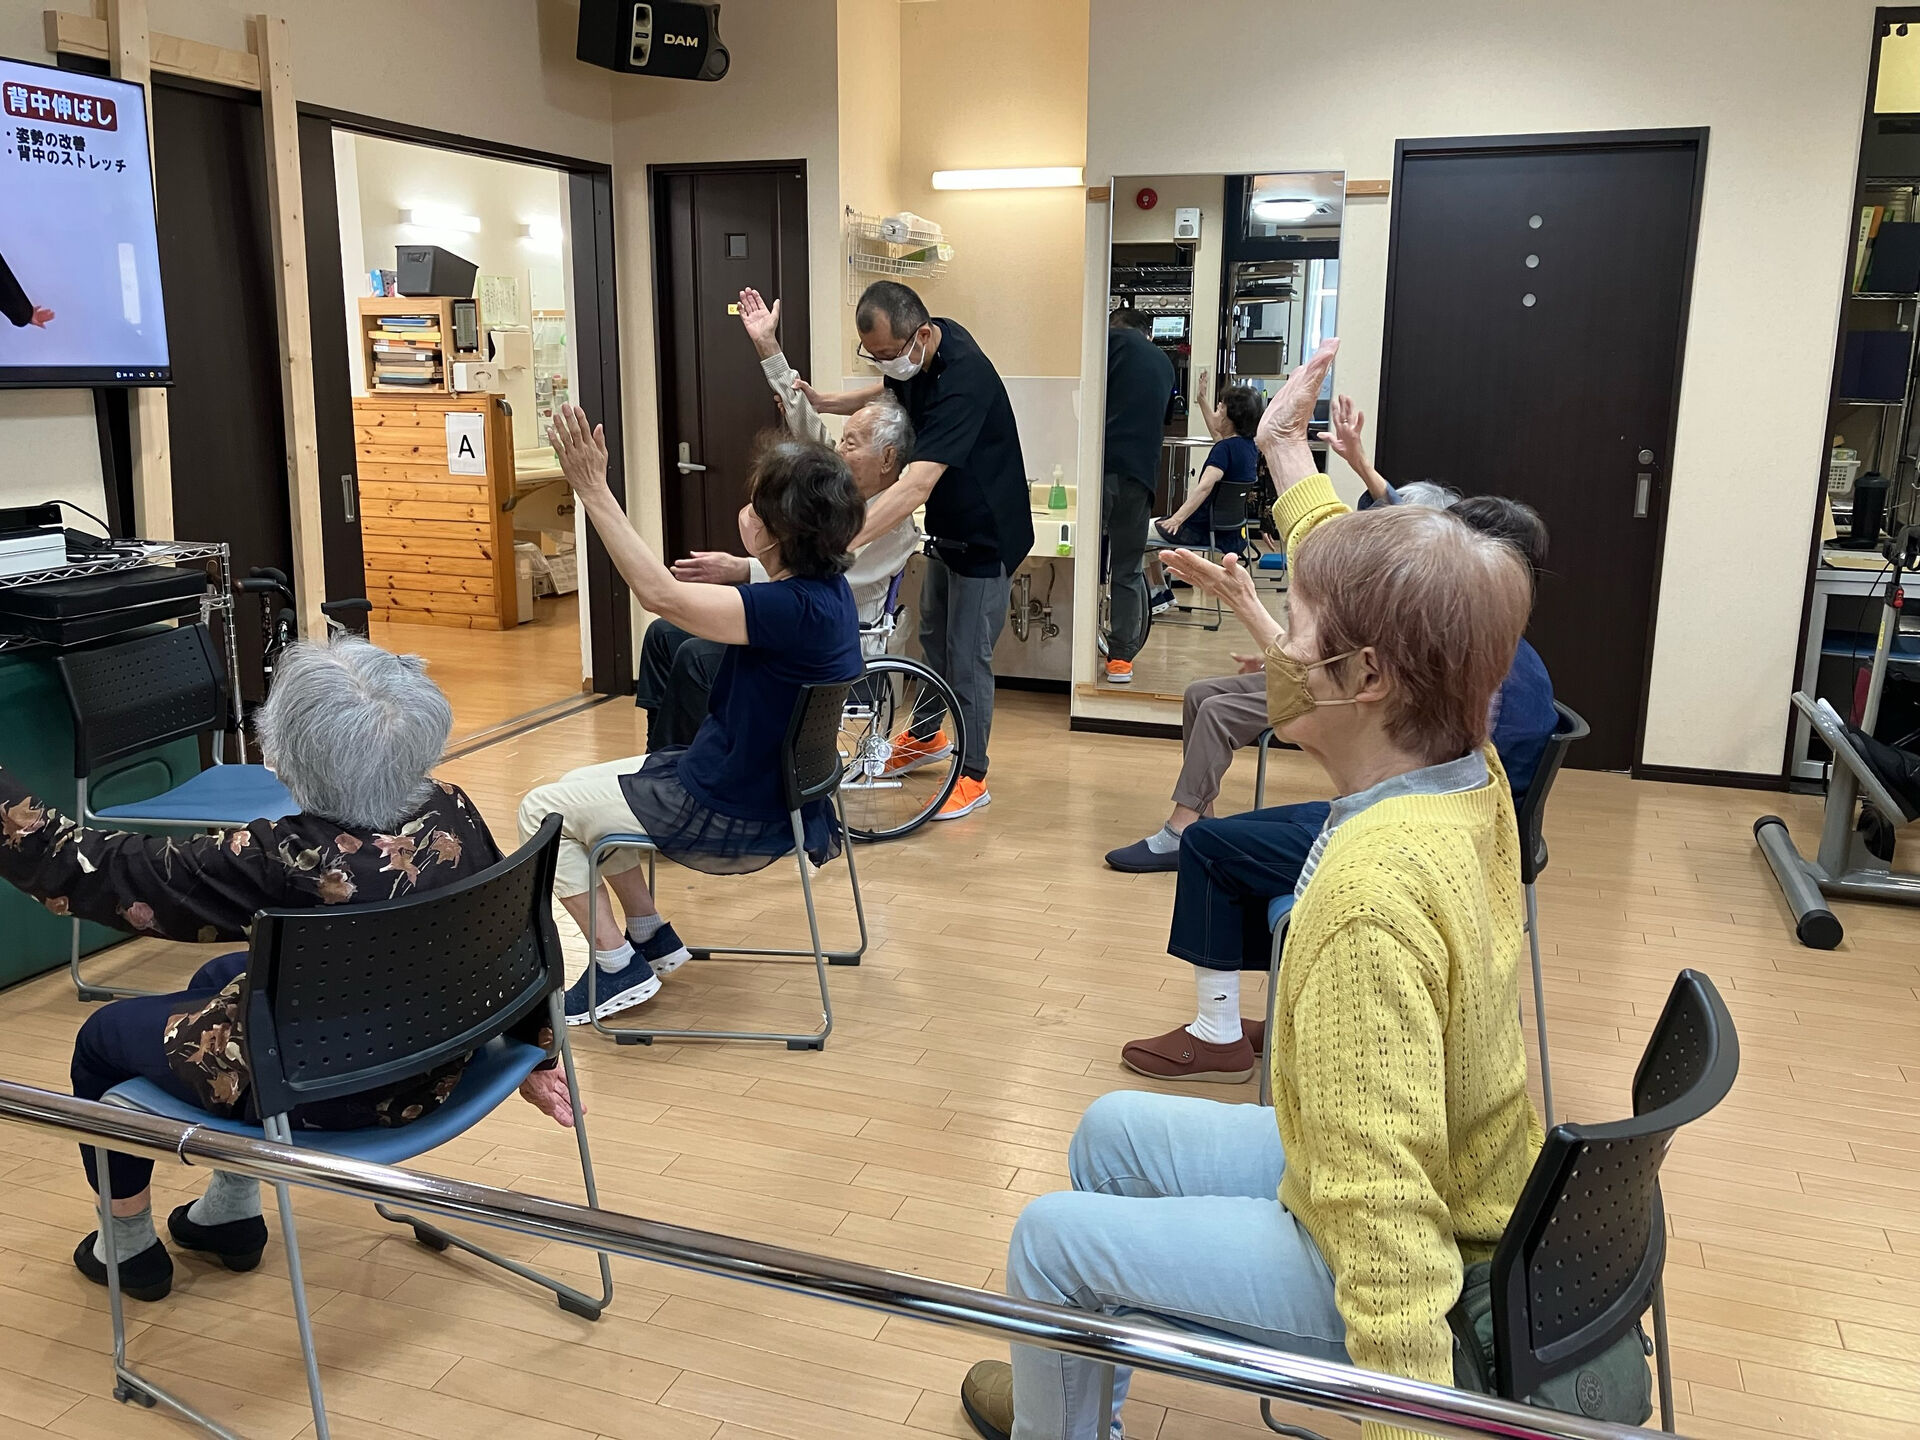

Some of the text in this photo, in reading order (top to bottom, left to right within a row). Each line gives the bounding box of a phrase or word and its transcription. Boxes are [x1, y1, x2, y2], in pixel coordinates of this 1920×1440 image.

[663, 33, 699, 48] DAM
[7, 86, 112, 125] 背中伸ばし
[457, 434, 475, 459] A
